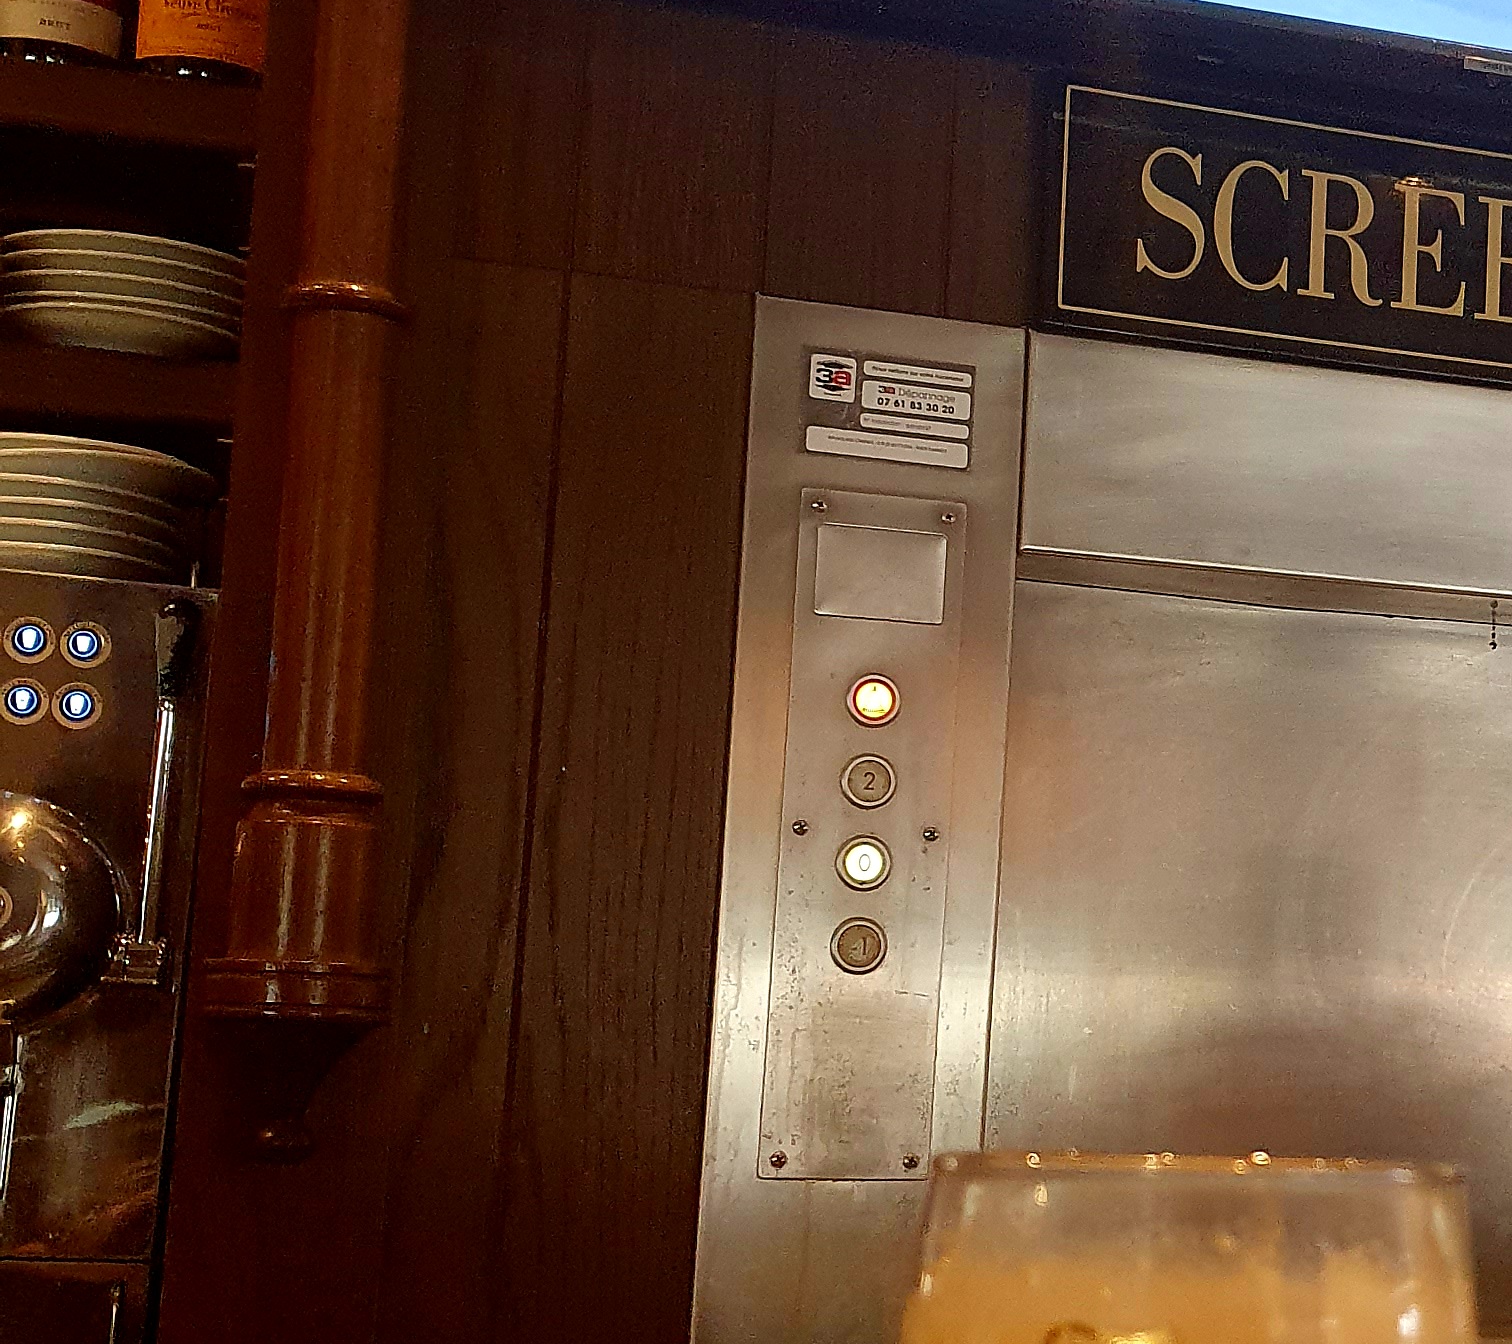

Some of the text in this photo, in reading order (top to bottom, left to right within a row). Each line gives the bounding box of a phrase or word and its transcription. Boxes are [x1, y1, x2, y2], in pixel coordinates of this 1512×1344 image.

[876, 396, 891, 408] 07
[893, 399, 906, 409] 61
[925, 402, 939, 413] 30
[941, 404, 955, 415] 20
[863, 771, 876, 790] 2
[858, 853, 871, 872] 0
